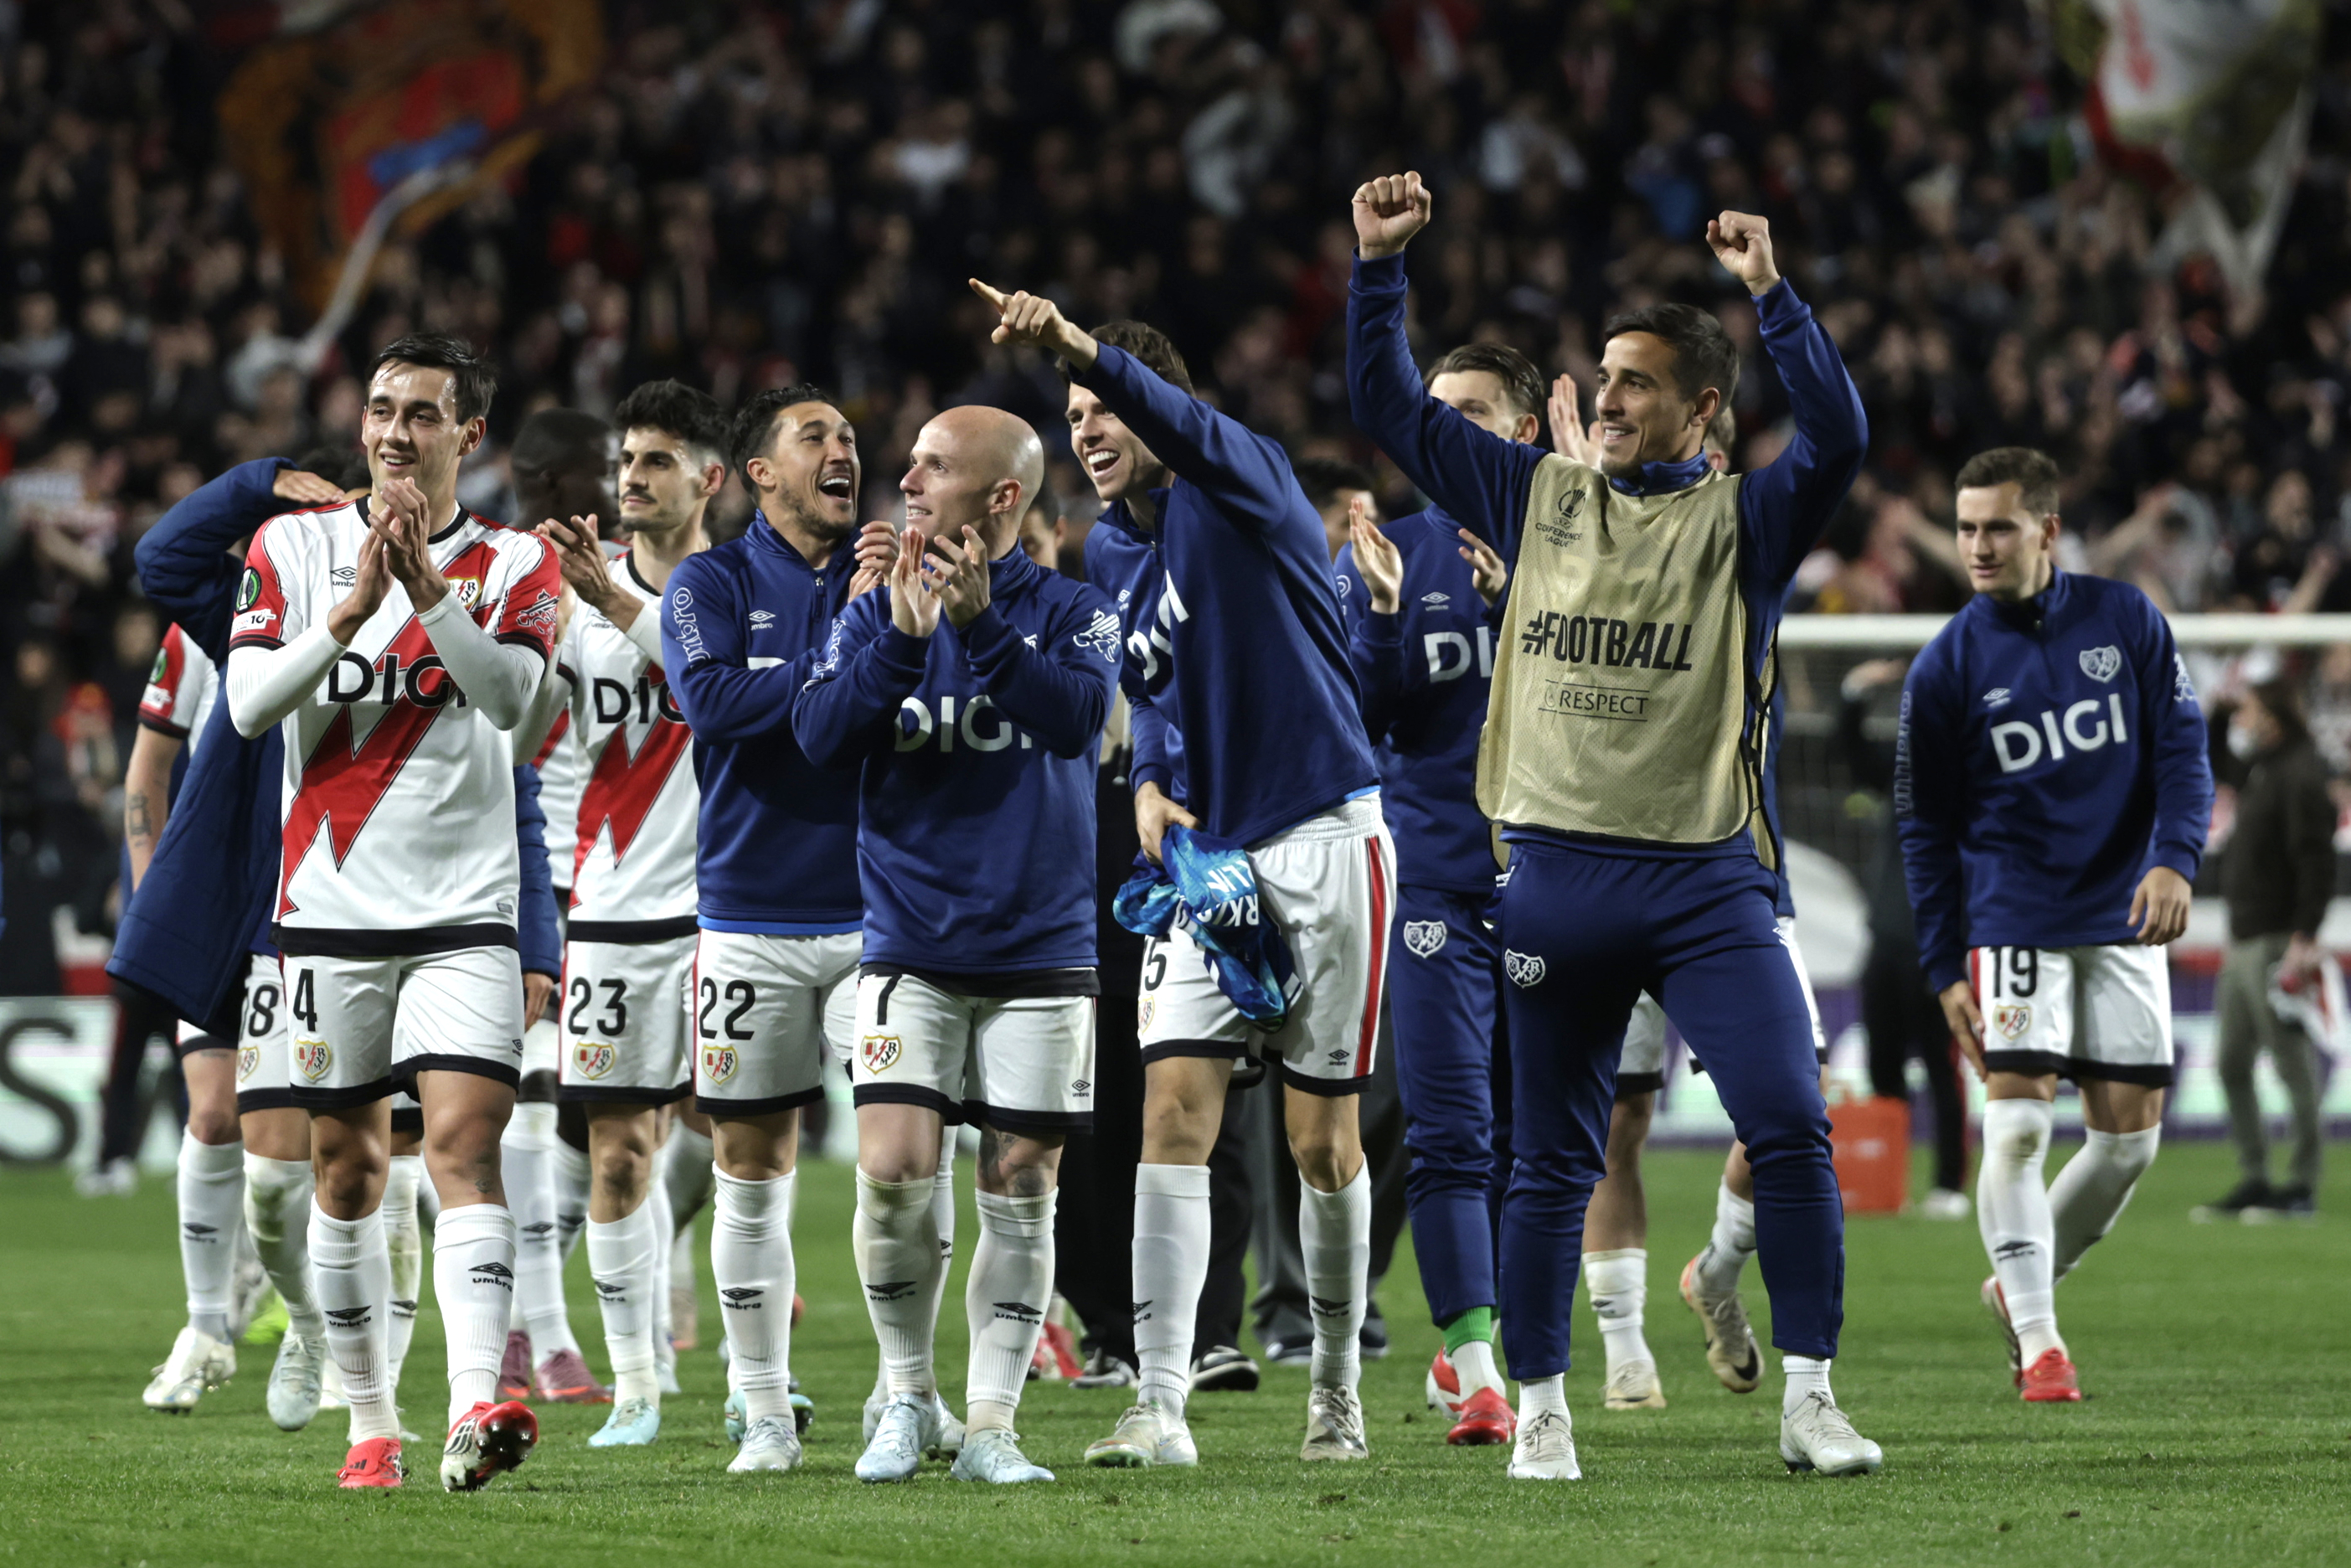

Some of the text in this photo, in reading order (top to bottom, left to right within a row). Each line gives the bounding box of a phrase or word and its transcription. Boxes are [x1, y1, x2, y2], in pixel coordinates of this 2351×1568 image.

[1521, 610, 1693, 671] #FOOTBALL
[1559, 689, 1649, 714] RESPECT
[1990, 693, 2127, 773] DIGI
[1144, 936, 1168, 992] 5
[1990, 946, 2037, 998] 19
[293, 968, 317, 1032] 4
[569, 977, 626, 1036] 23
[699, 977, 755, 1040] 22
[874, 973, 903, 1026] 7
[329, 1316, 371, 1328] umbro
[869, 1290, 916, 1301] umbro
[995, 1312, 1040, 1325] umbro
